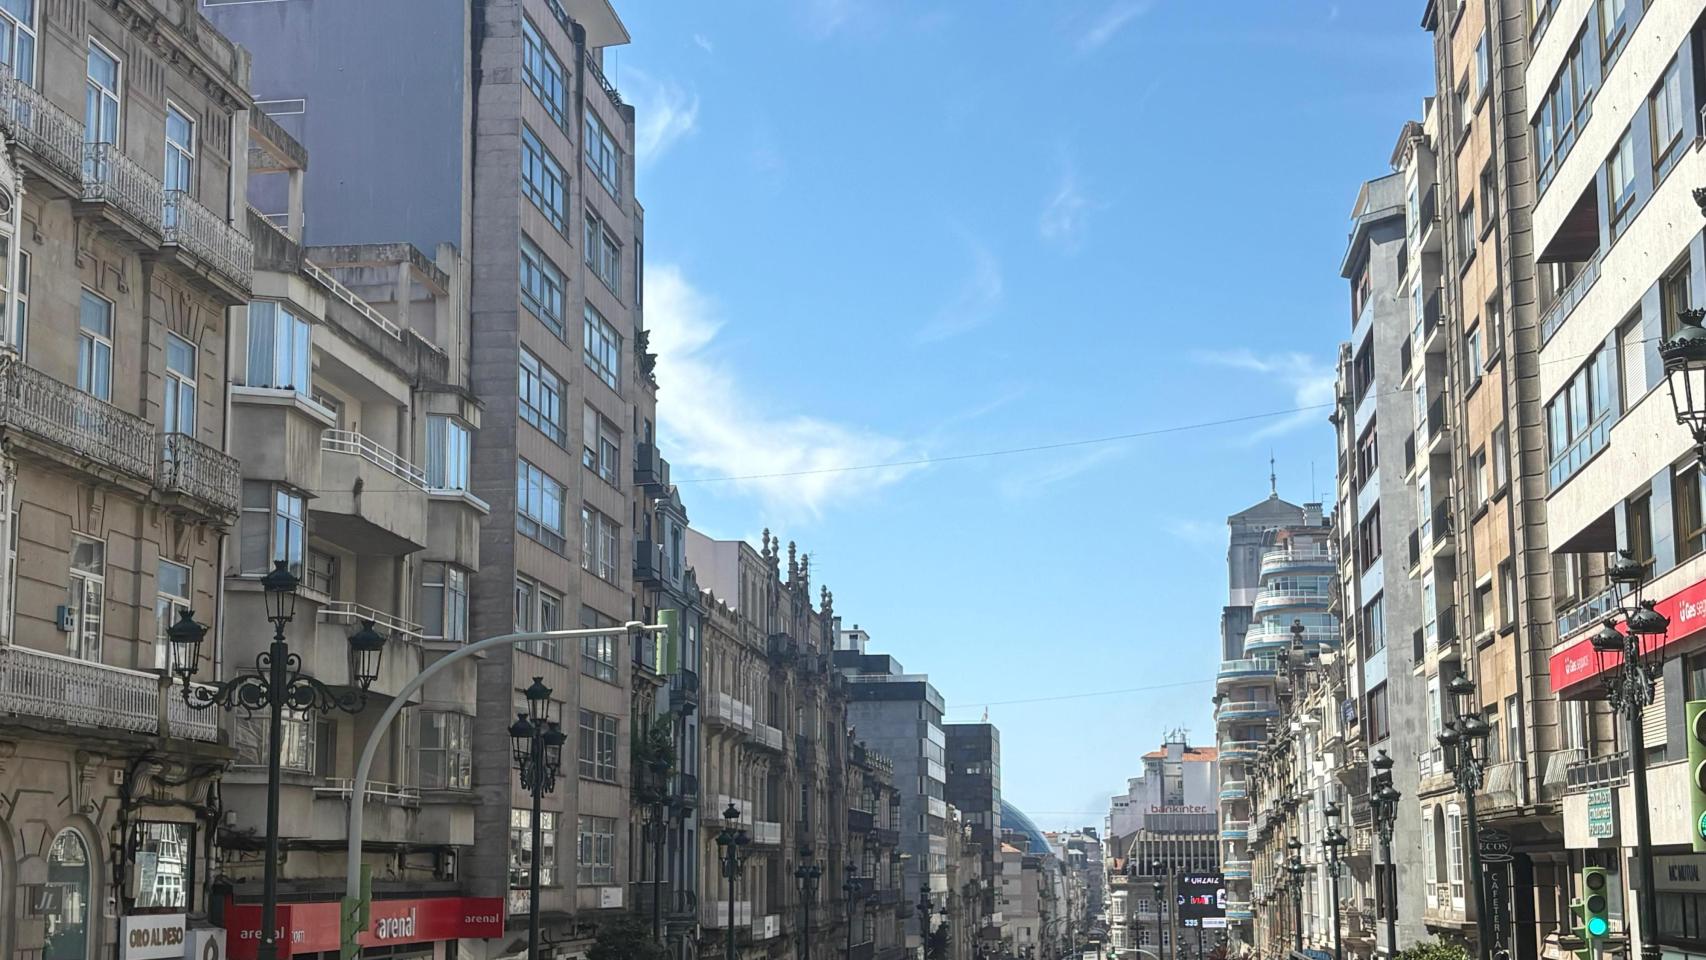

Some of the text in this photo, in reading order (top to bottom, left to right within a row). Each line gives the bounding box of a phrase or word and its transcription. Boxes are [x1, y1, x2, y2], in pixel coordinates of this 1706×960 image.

[1151, 804, 1207, 813] bankinter
[464, 913, 499, 924] arenal
[1491, 873, 1502, 949] CAFETERIA
[378, 907, 416, 939] arenal
[129, 927, 184, 948] ORO AL PESO
[240, 926, 285, 940] areal
